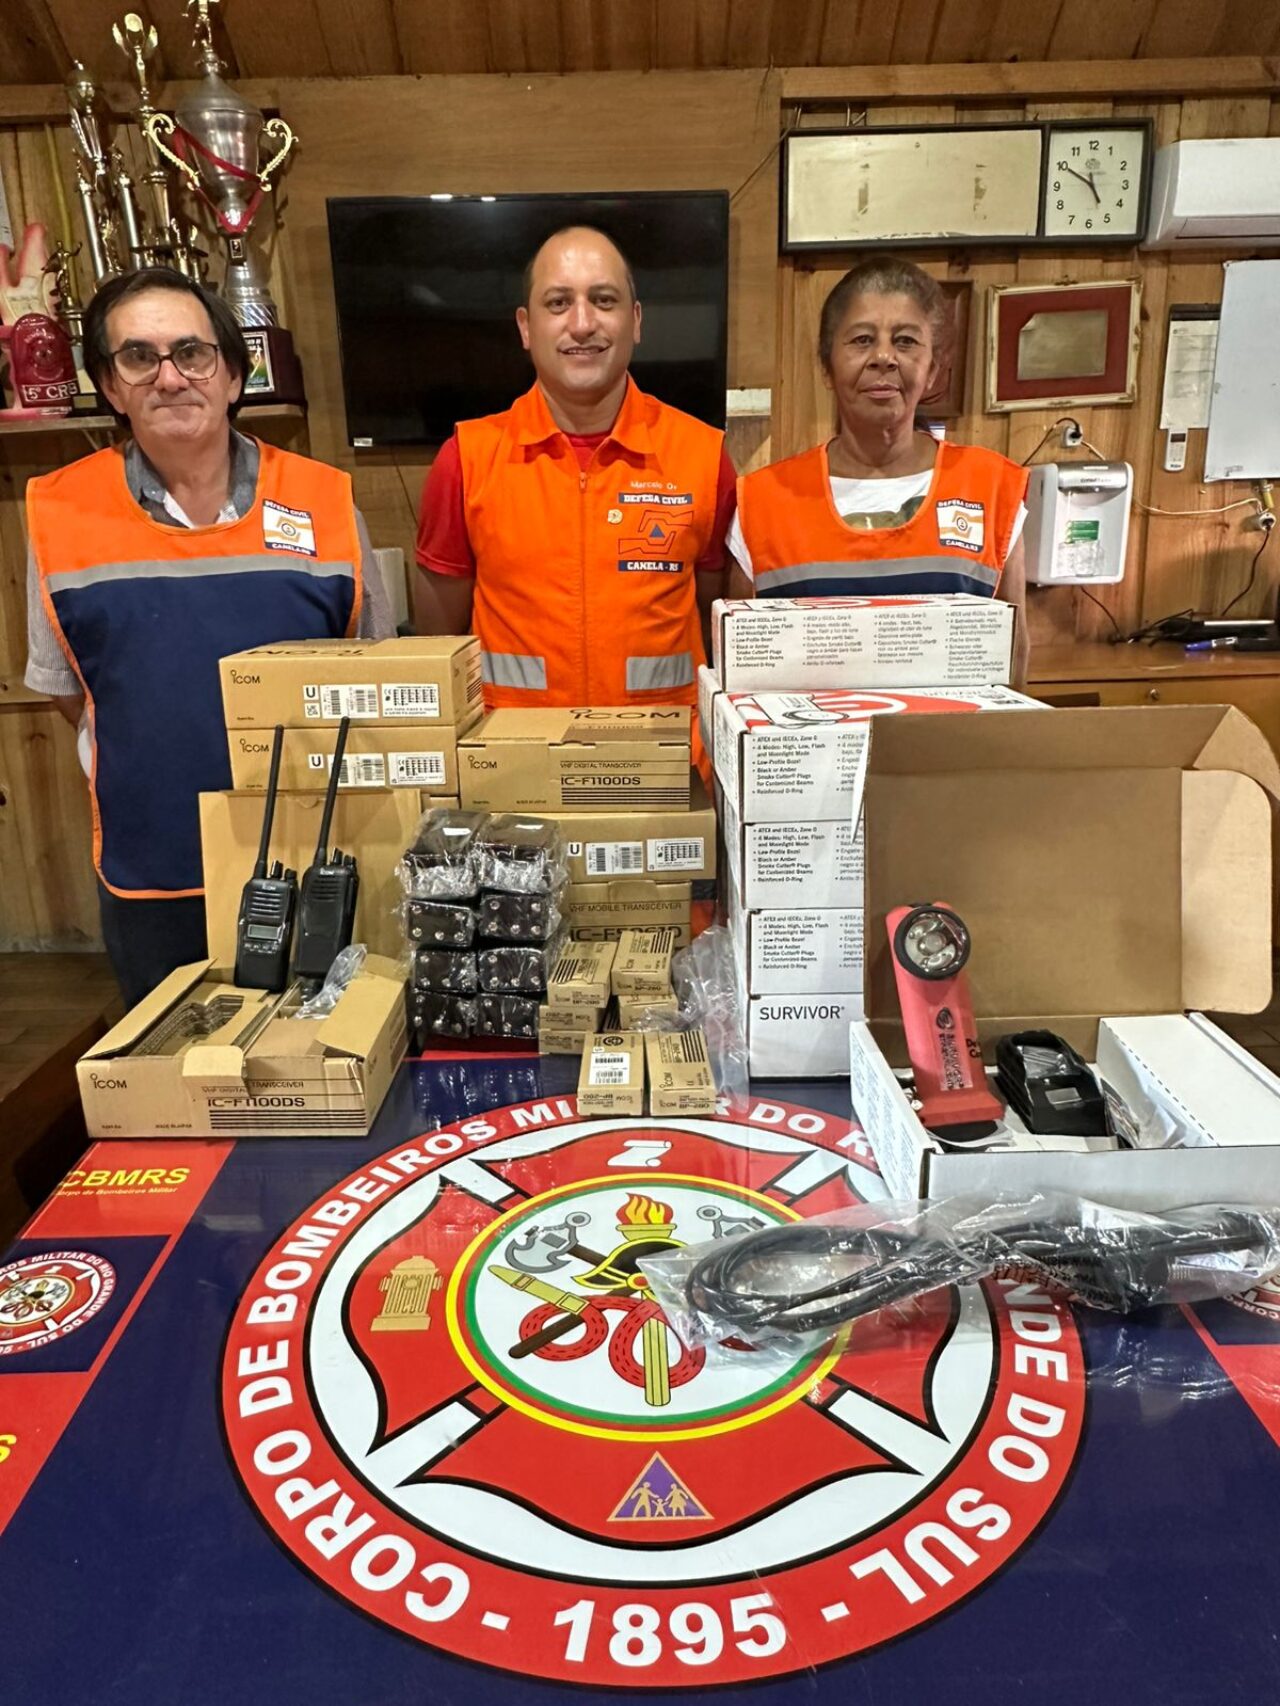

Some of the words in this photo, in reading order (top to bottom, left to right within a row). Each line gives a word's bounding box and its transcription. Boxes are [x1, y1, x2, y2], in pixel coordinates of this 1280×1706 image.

[1071, 146, 1080, 156] 11
[1089, 140, 1100, 151] 12
[1108, 146, 1113, 156] 1
[1056, 160, 1068, 171] 10
[1120, 160, 1127, 171] 2
[1053, 181, 1061, 191] 9
[1122, 179, 1129, 190] 3
[1056, 200, 1064, 210] 8
[1116, 198, 1124, 208] 4
[1068, 215, 1075, 225] 7
[1103, 213, 1111, 223] 5
[1085, 219, 1092, 229] 6
[623, 494, 660, 503] DEFESA
[662, 496, 688, 504] CIVIL
[306, 687, 316, 698] U
[311, 756, 321, 767] U
[561, 776, 641, 786] IC-F1100DS
[570, 844, 580, 855] U
[588, 903, 620, 912] MOBILE
[622, 902, 681, 911] TRANSCEIVER
[749, 1102, 826, 1134] DO
[58, 1167, 191, 1188] CBMRS
[96, 1188, 147, 1196] Bombeiros
[246, 1118, 498, 1325] BOMBEIROS
[31, 1251, 86, 1263] MILITAR
[86, 1255, 102, 1265] DO
[62, 1319, 84, 1334] DO
[27, 1332, 59, 1348] SUL
[238, 1339, 293, 1418] DE
[988, 1393, 1066, 1483] DO
[253, 1429, 471, 1623] CORPO
[849, 1487, 1012, 1604] SUL
[553, 1592, 787, 1667] 1895
